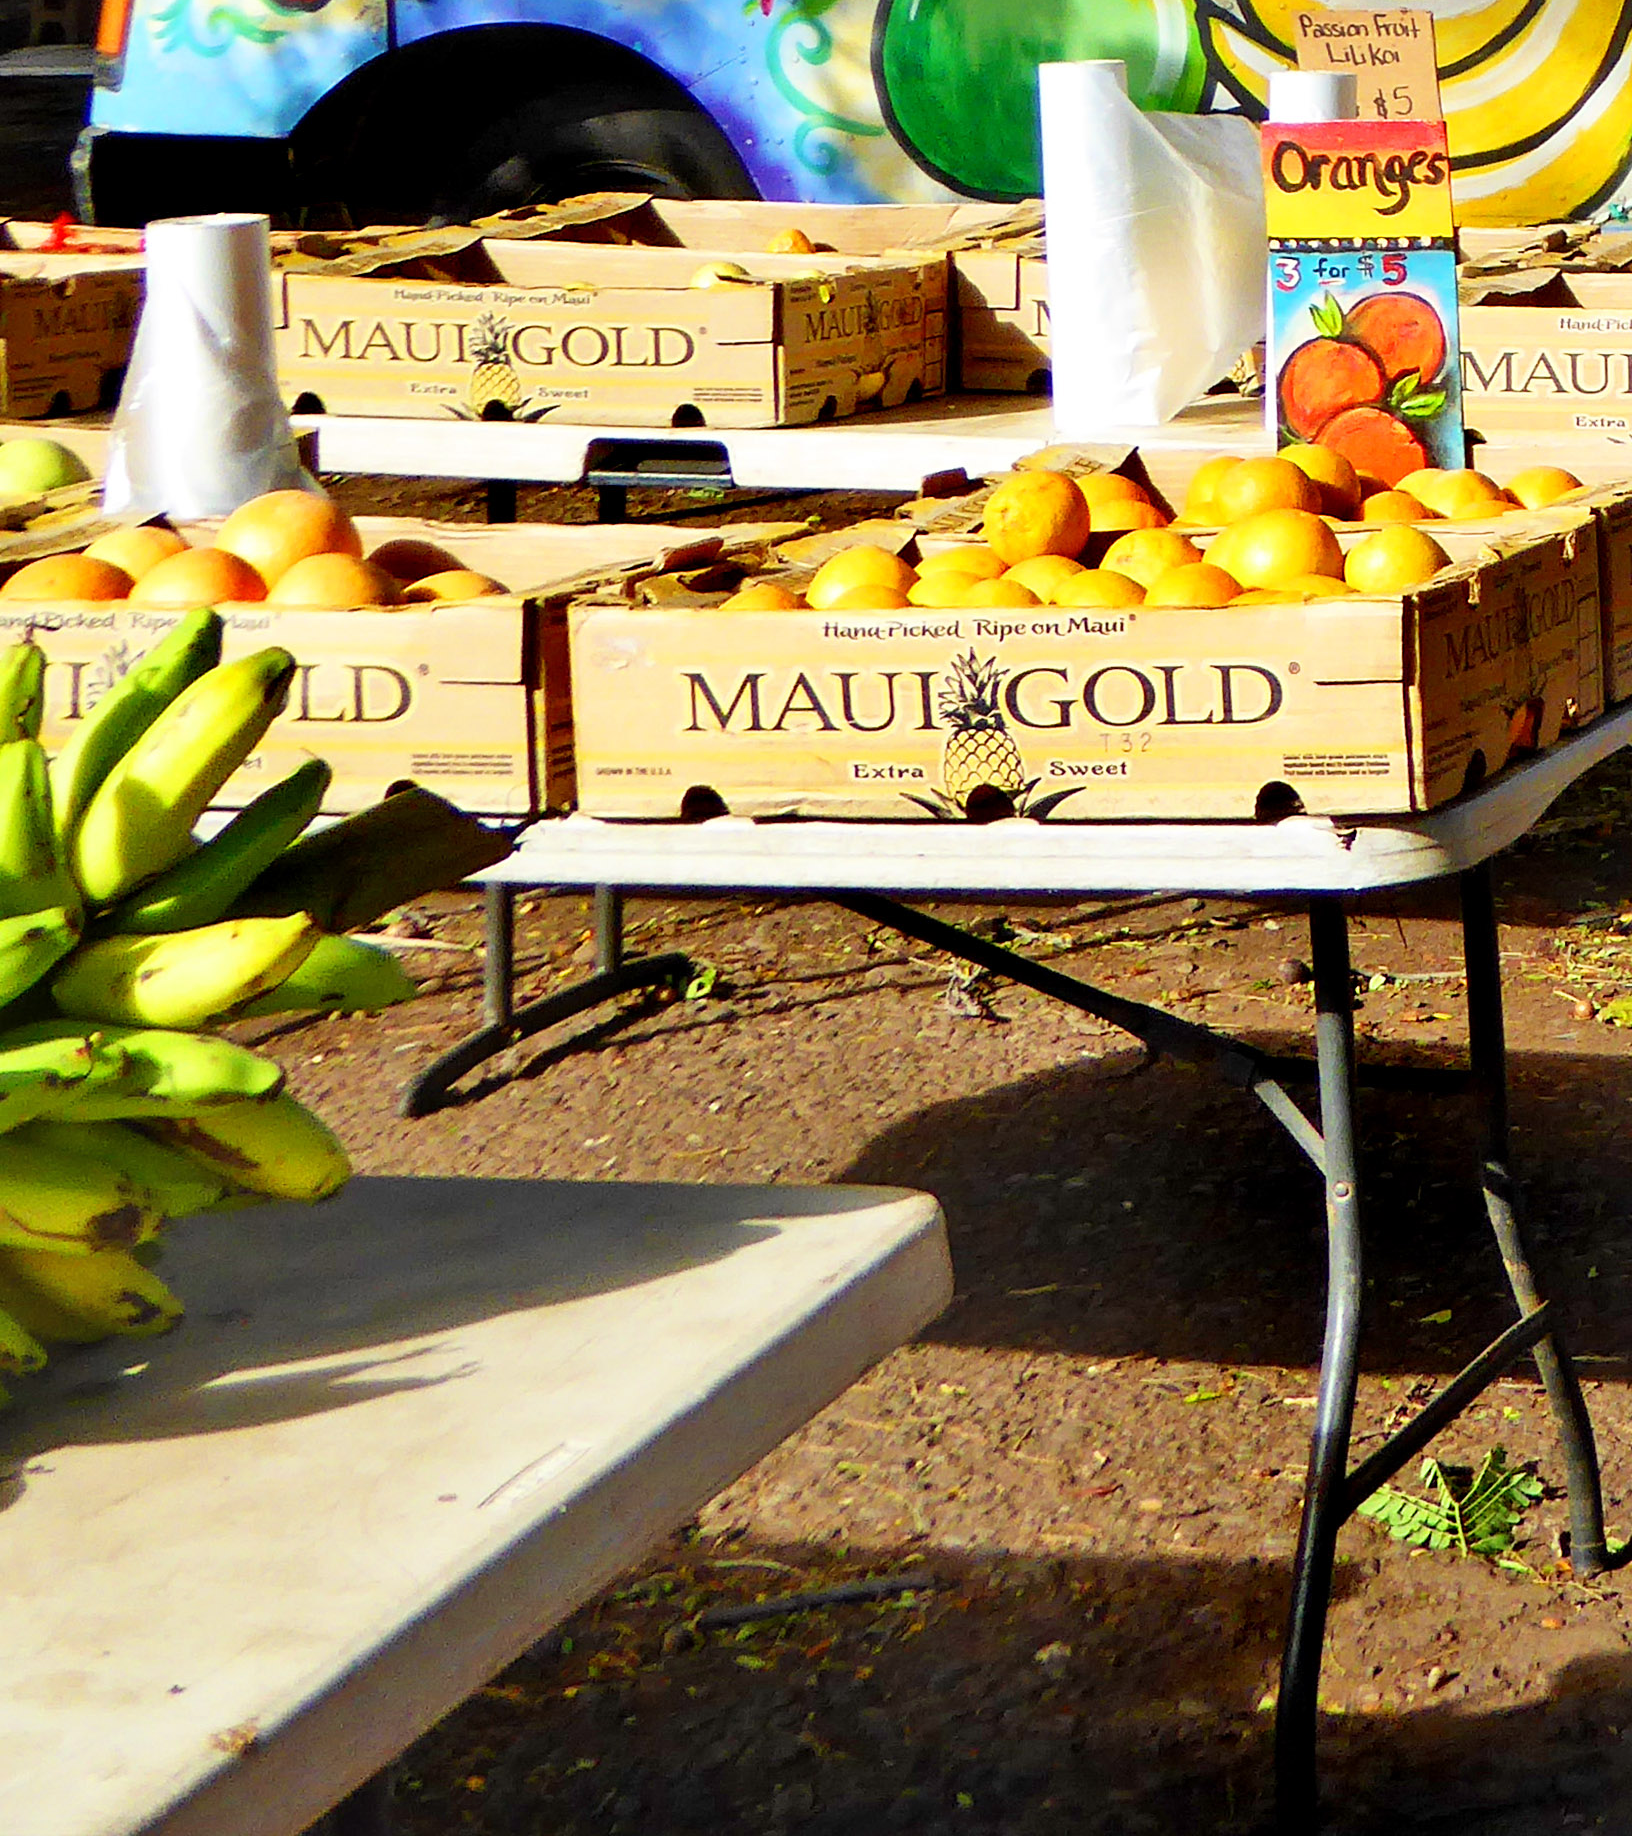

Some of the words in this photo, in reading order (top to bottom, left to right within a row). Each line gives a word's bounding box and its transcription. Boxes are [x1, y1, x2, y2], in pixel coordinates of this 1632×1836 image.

[1299, 14, 1368, 38] Passion
[1373, 14, 1420, 39] Fruit
[1272, 141, 1446, 215] Oranges
[1276, 256, 1301, 291] 3
[1313, 258, 1350, 279] for
[805, 305, 866, 343] MAUI
[299, 318, 469, 363] MAUI
[511, 325, 696, 368] GOLD
[409, 382, 458, 395] Extra
[538, 386, 590, 399] Sweet
[1575, 415, 1627, 429] Extra
[823, 620, 964, 640] Hand-Picked
[973, 618, 1027, 642] Ripe
[1031, 622, 1064, 637] on
[1066, 617, 1127, 635] Maui
[1444, 605, 1513, 679] MAUI
[294, 664, 412, 723] LD
[681, 672, 944, 733] MAUI
[1003, 664, 1284, 729] GOLD
[853, 763, 925, 780] Extra
[1048, 760, 1128, 777] Sweet
